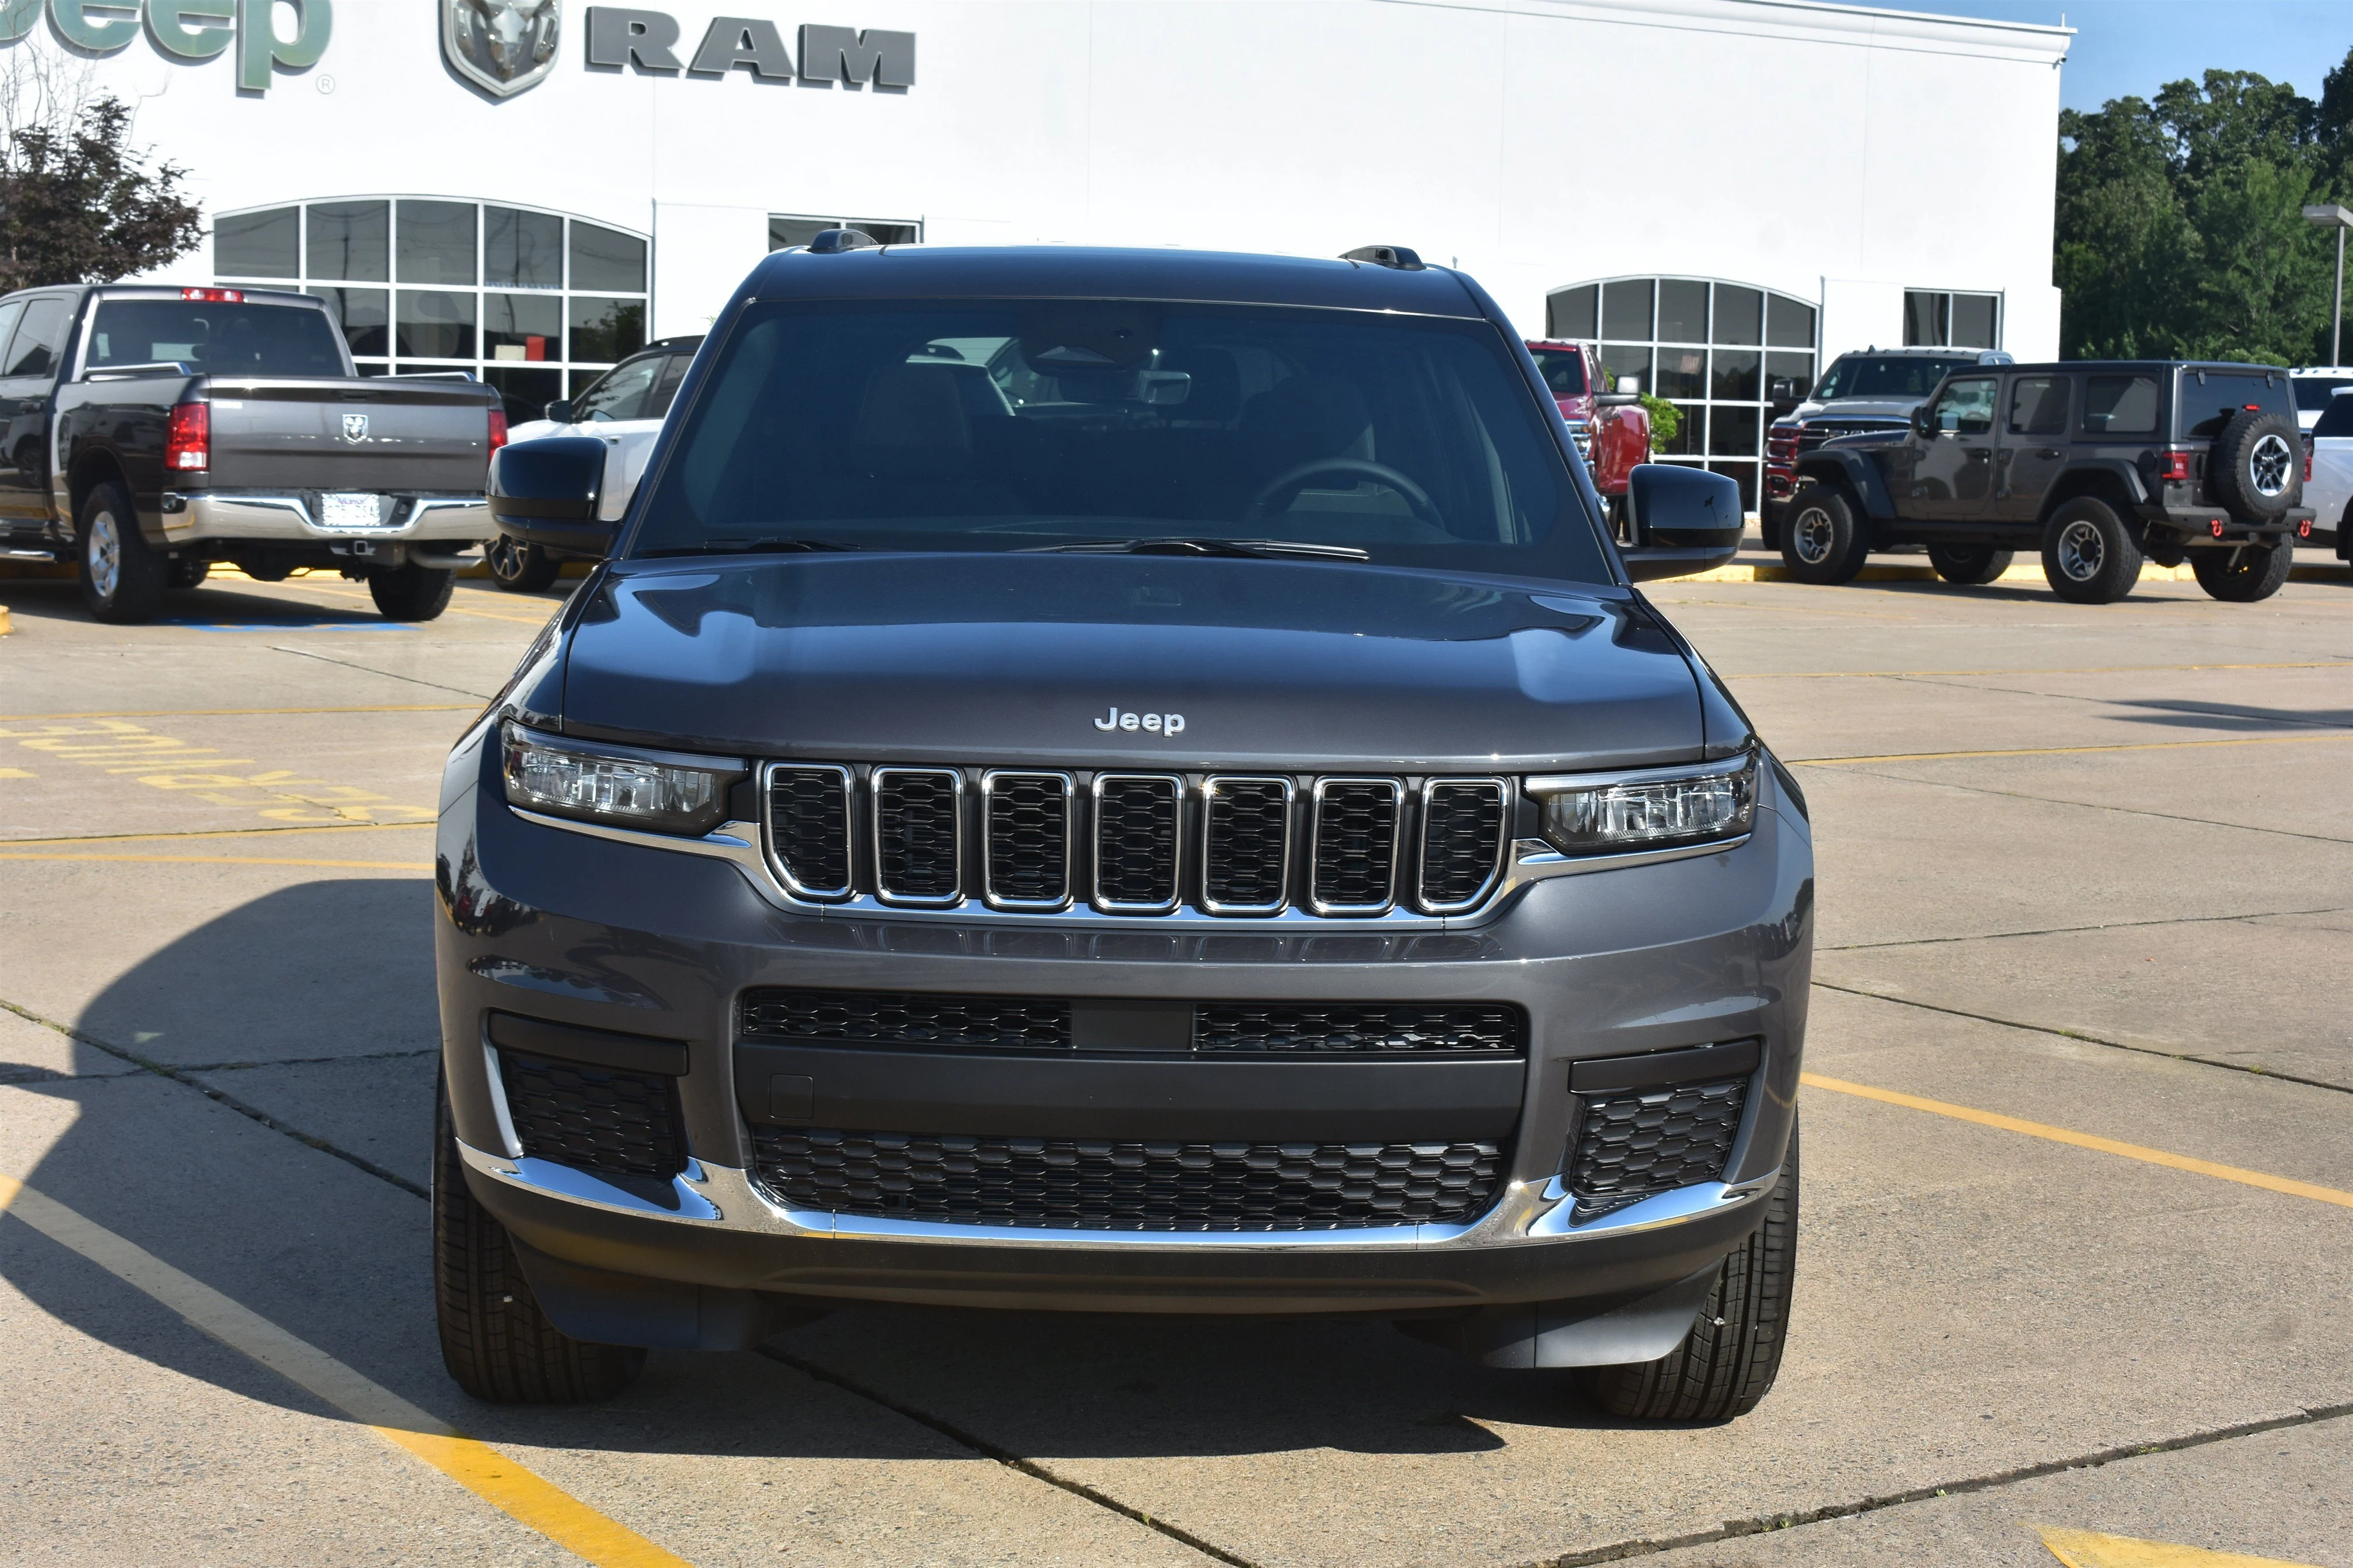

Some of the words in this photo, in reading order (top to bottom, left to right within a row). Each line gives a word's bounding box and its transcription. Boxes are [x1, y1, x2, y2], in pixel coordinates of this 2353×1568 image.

[0, 0, 333, 90] eep
[585, 6, 916, 86] RAM
[1093, 707, 1185, 737] Jeep
